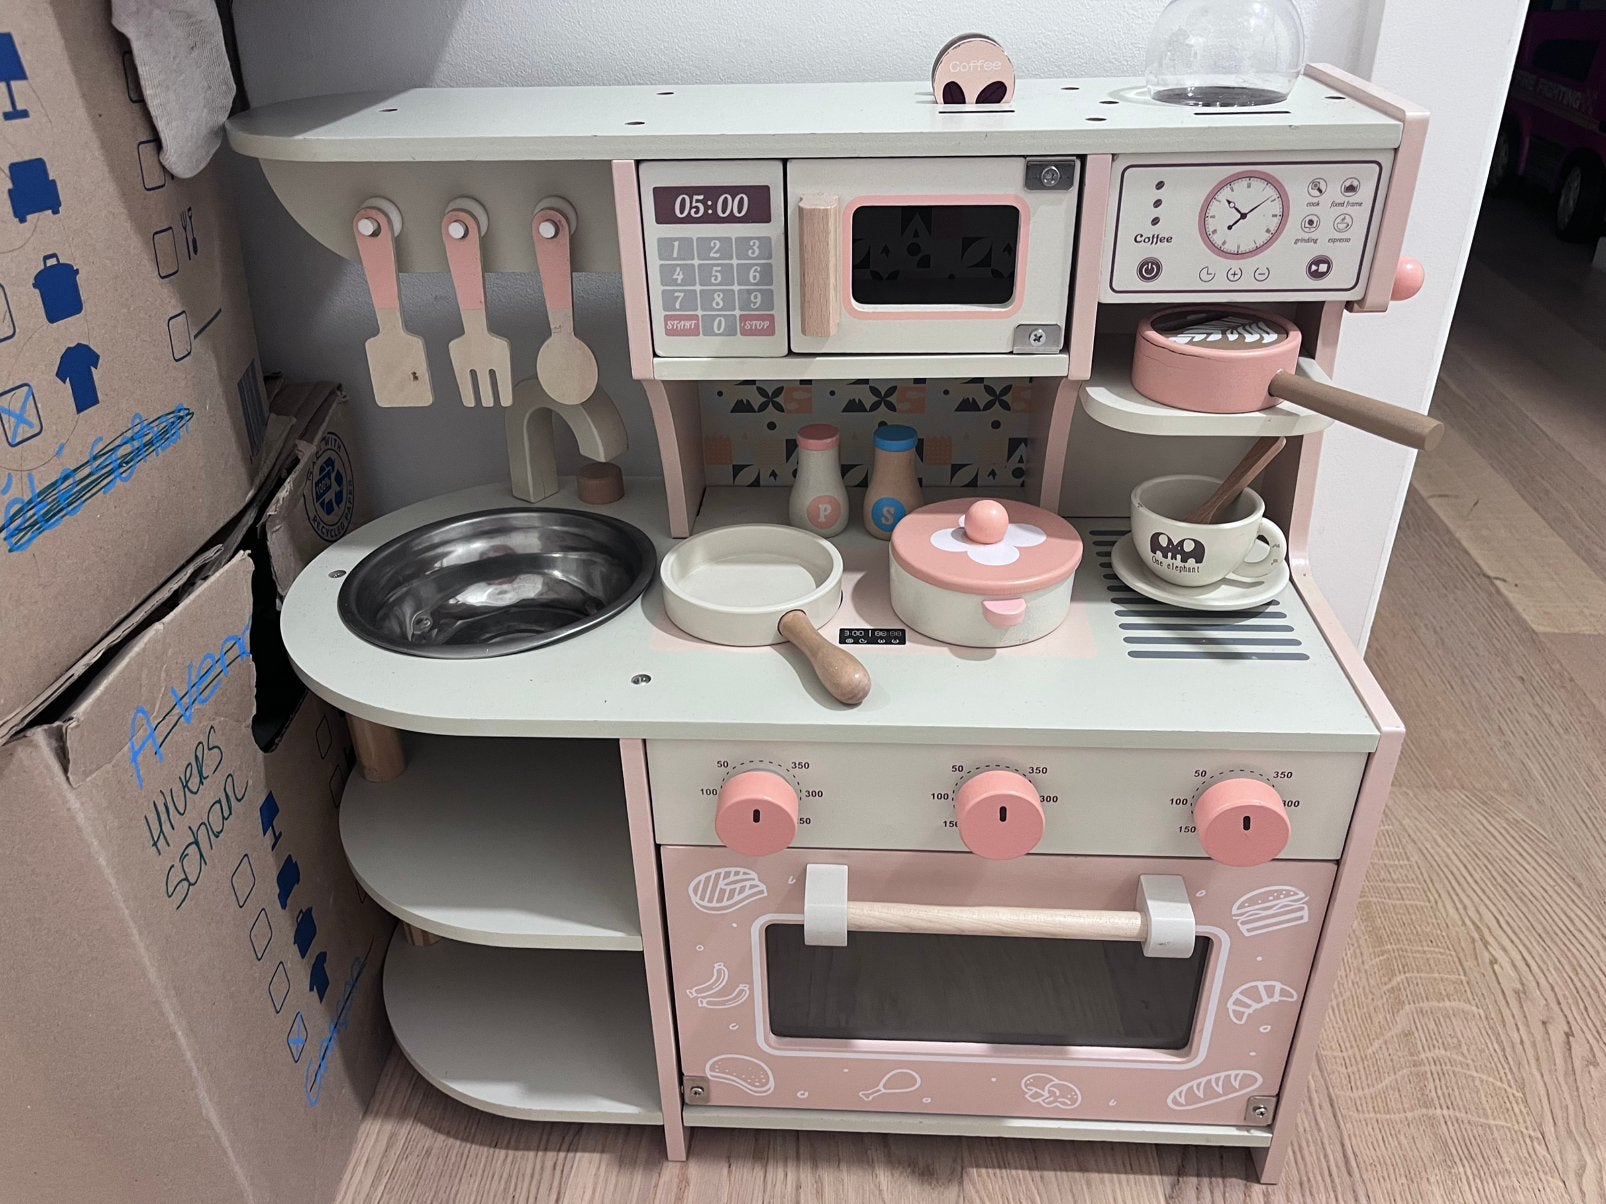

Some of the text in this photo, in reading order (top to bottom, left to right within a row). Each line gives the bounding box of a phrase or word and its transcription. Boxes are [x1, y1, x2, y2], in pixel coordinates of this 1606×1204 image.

[949, 60, 1002, 72] Coffee
[674, 193, 748, 218] 05:00
[1133, 233, 1173, 246] Coffee
[672, 241, 680, 258] 1
[710, 240, 720, 258] 2
[748, 239, 760, 257] 3
[672, 266, 684, 283] 4
[711, 266, 721, 283] 5
[749, 266, 761, 283] 6
[674, 292, 684, 309] 7
[712, 292, 724, 309] 8
[751, 292, 762, 308] 9
[666, 320, 697, 330] START
[713, 317, 725, 333] 0
[744, 320, 770, 330] STOP
[818, 503, 832, 522] P
[881, 506, 896, 525] S
[312, 514, 345, 539] RECYCLED
[1151, 555, 1200, 574] One elephant
[716, 760, 729, 769] 50
[791, 761, 810, 770] 350
[951, 765, 964, 773] 50
[1028, 766, 1048, 774] 350
[1194, 769, 1207, 778] 50
[1273, 771, 1293, 779] 350
[700, 788, 718, 796] 100
[804, 790, 823, 798] 300
[1039, 795, 1058, 803] 300
[1169, 798, 1188, 806] 100
[797, 817, 811, 825] 50
[1178, 825, 1197, 834] 150
